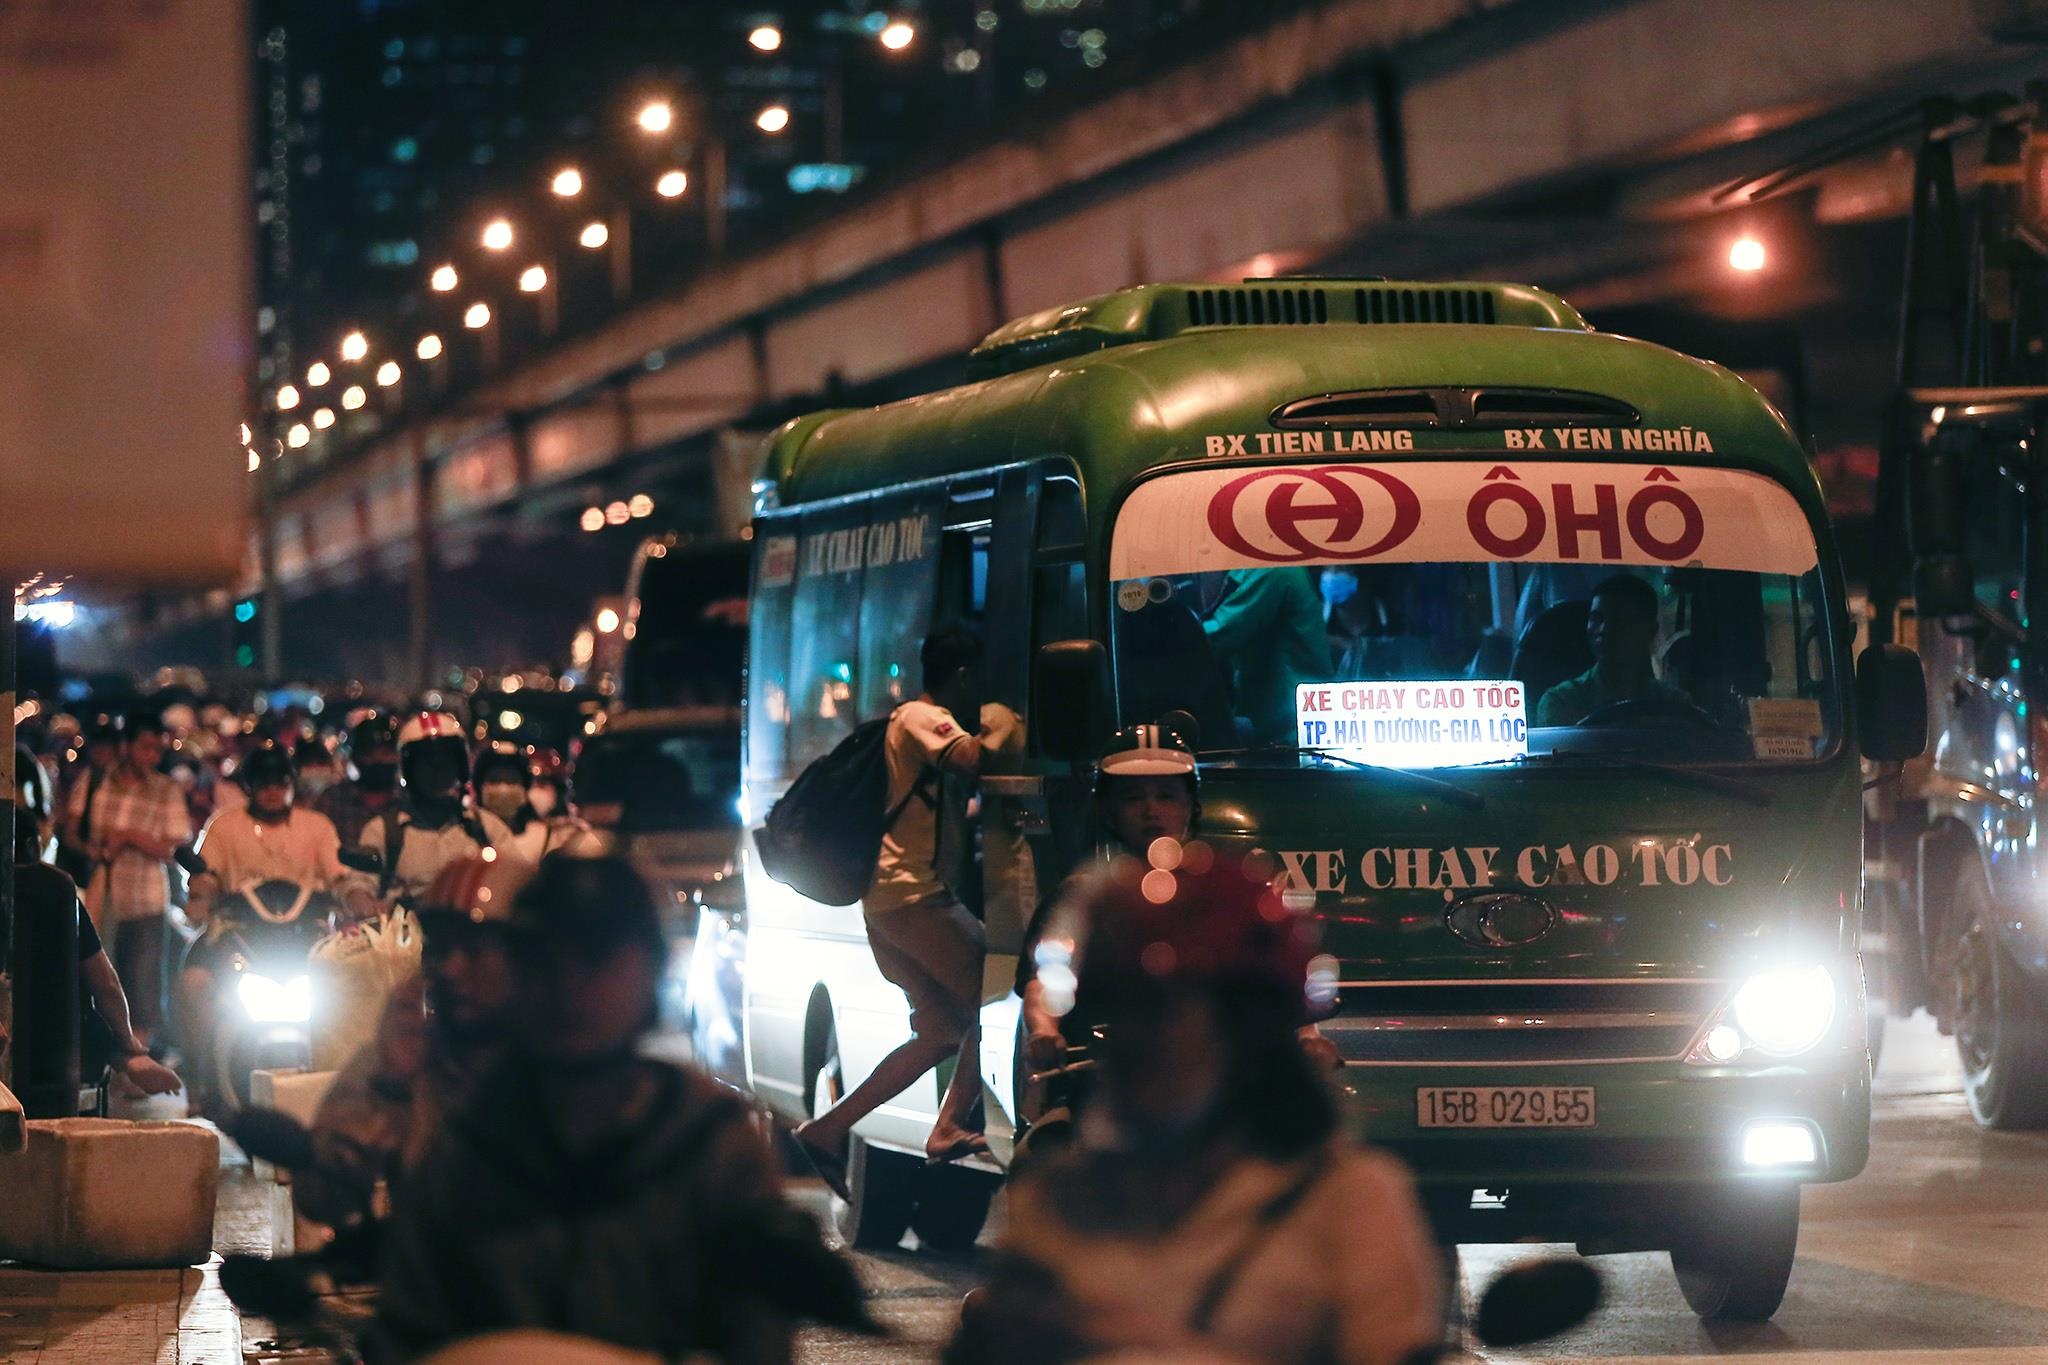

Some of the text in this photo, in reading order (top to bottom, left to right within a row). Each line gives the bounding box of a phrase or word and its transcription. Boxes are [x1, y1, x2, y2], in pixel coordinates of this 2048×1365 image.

[1206, 429, 1413, 457] BX TIEN LANG
[1504, 426, 1714, 453] BX YEN NGHĨA
[1466, 465, 1705, 562] ÔHÔ
[1302, 690, 1332, 712] XE
[1416, 688, 1465, 709] CAO
[1303, 720, 1331, 745] TP.
[1280, 832, 1734, 901] XE CHẠY CAO TỐC
[1427, 1089, 1590, 1123] 15B 029.55
